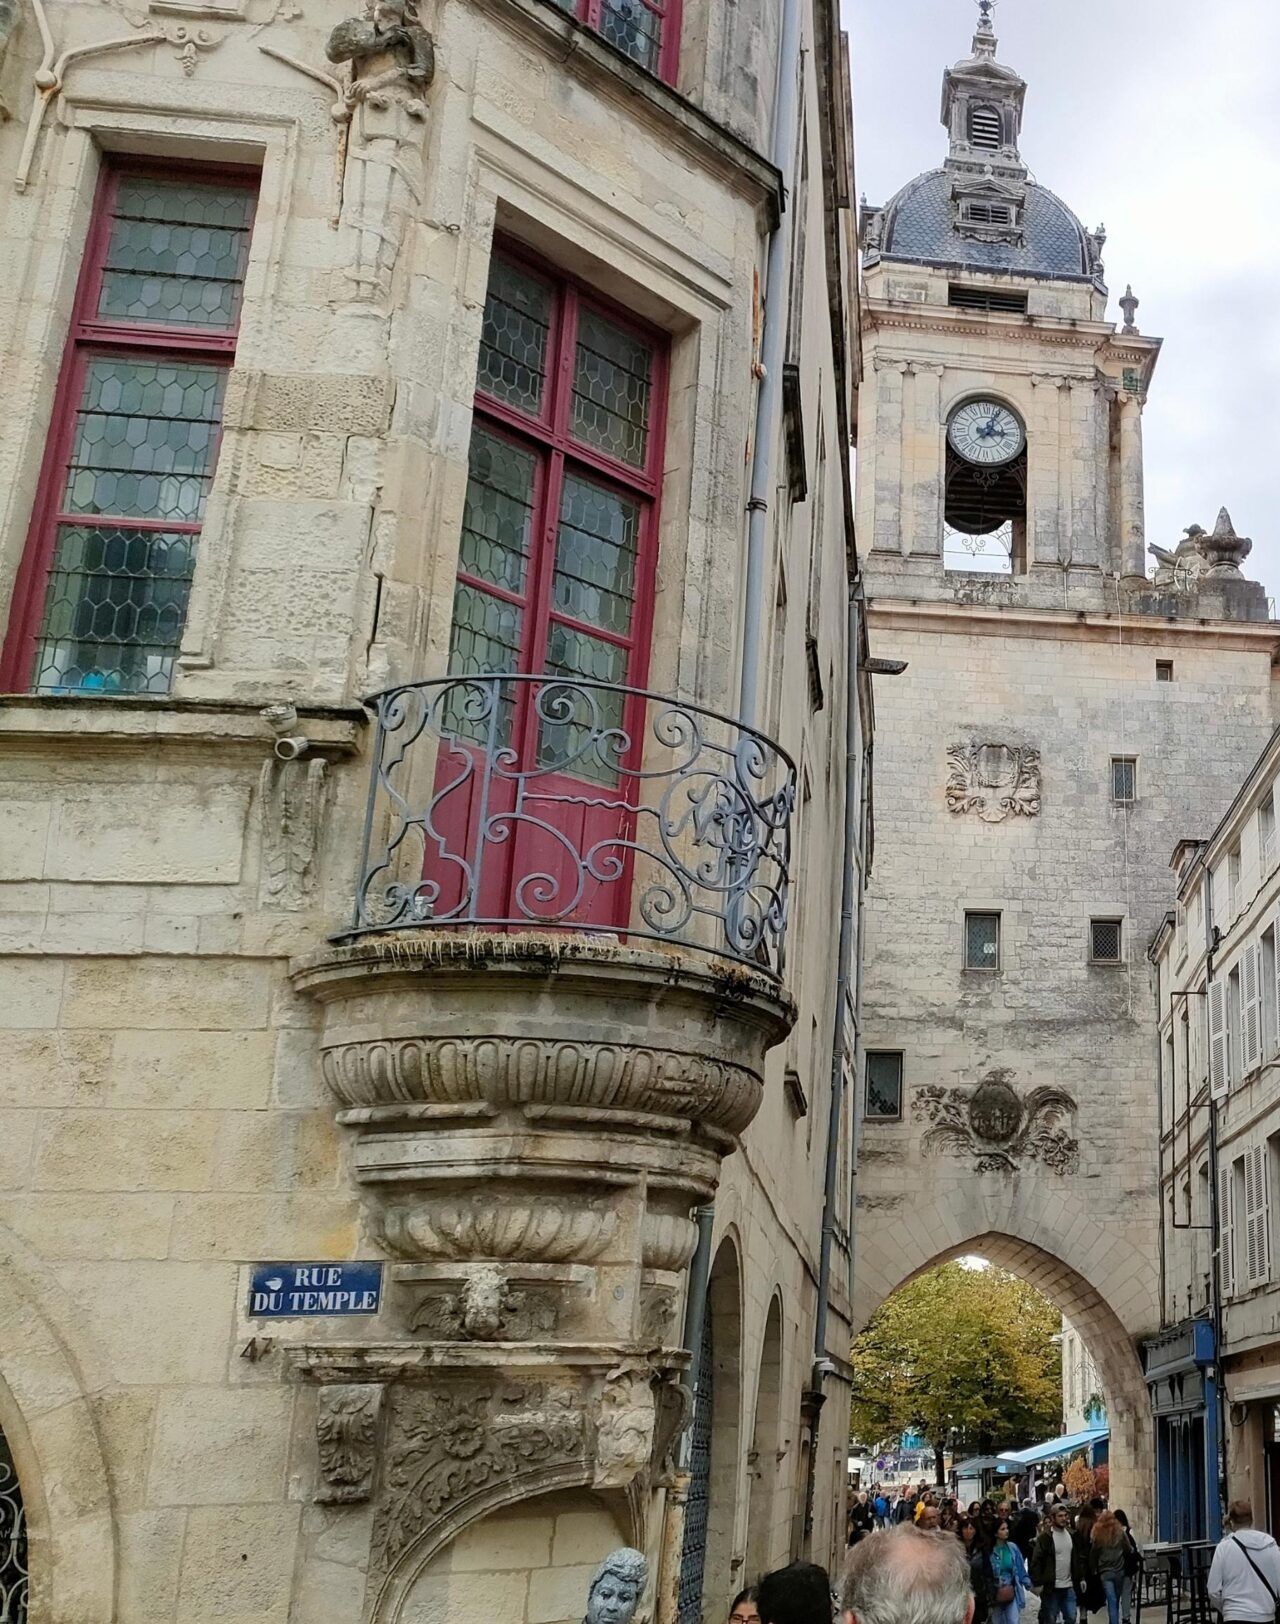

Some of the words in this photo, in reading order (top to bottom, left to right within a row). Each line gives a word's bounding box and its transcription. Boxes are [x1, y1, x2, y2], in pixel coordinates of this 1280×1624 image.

[294, 1267, 342, 1287] RUE
[253, 1292, 284, 1311] DU
[289, 1290, 377, 1311] TEMPLE
